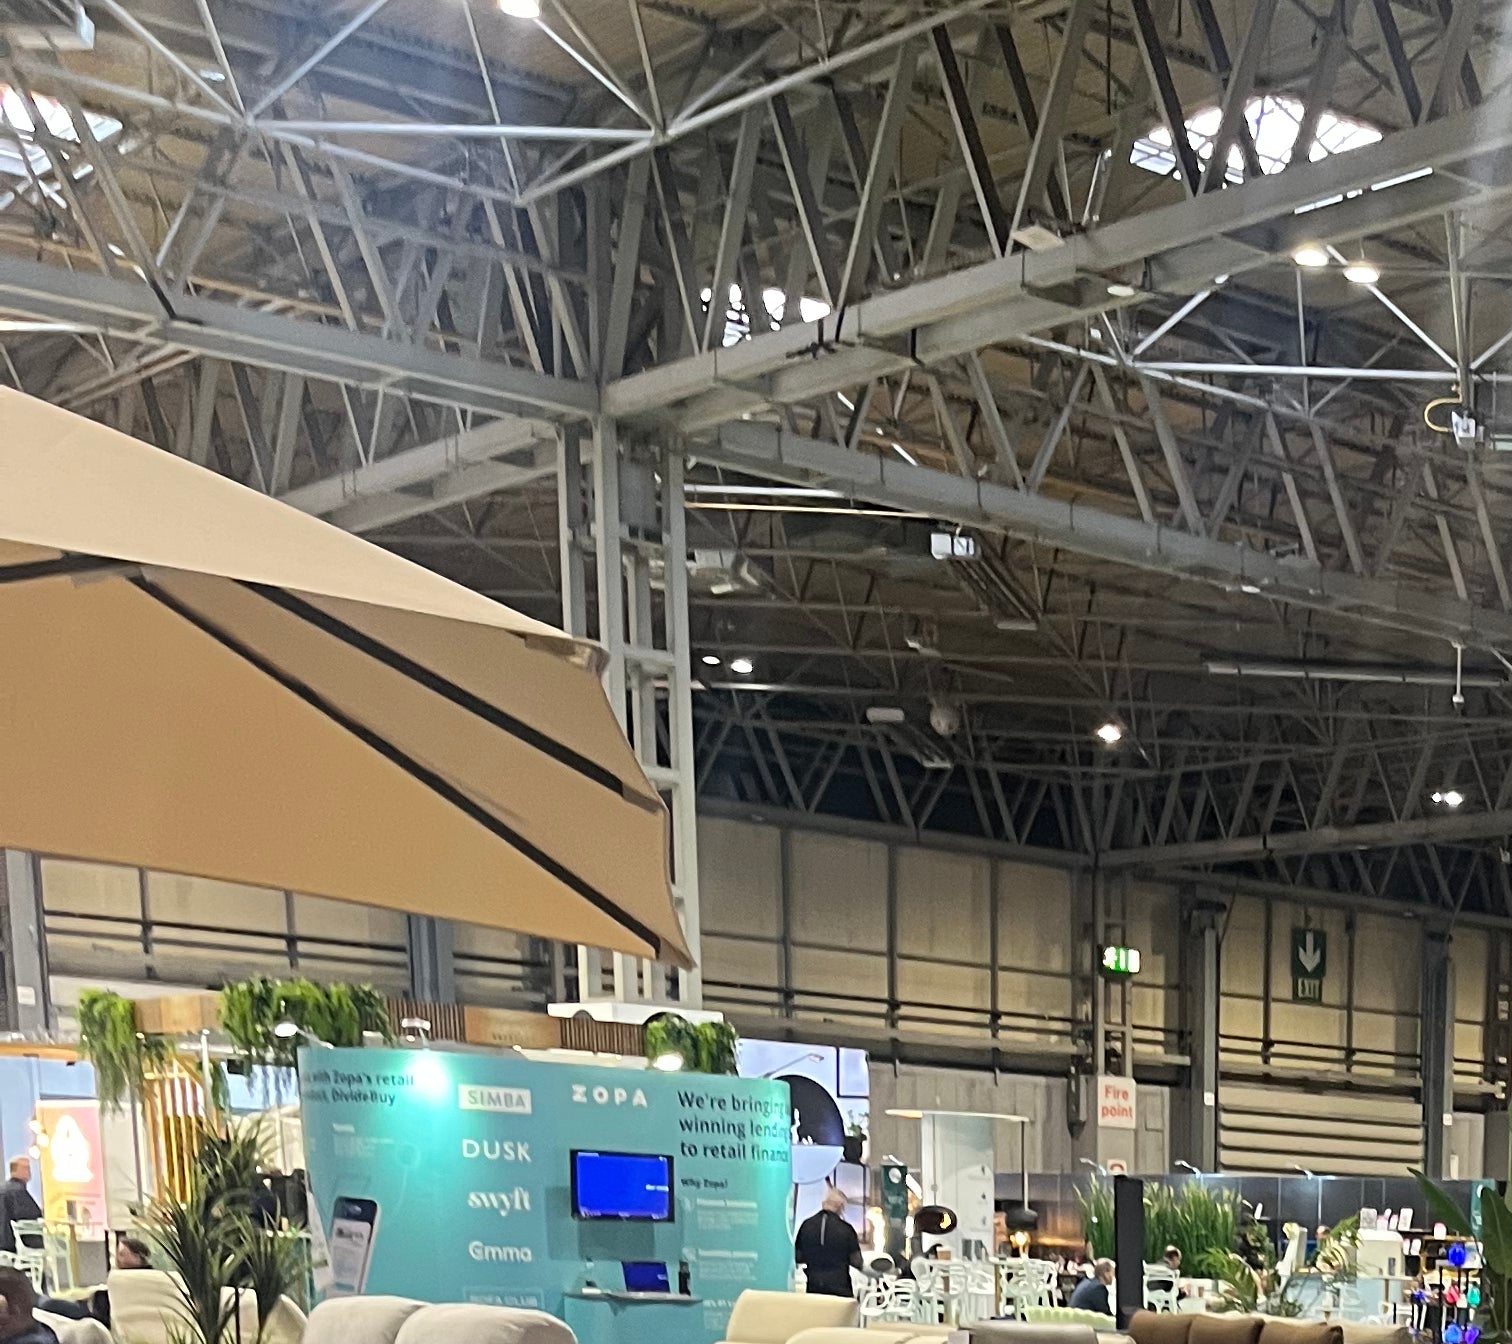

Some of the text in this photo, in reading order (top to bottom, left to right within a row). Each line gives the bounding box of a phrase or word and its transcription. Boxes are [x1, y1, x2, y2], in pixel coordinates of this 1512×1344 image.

[1298, 978, 1320, 999] EXIT
[467, 1089, 527, 1109] SIMBA
[571, 1083, 648, 1108] ZOPA
[677, 1090, 727, 1111] We're
[1104, 1085, 1129, 1101] Fire
[1101, 1105, 1133, 1122] point
[678, 1115, 746, 1140] winning
[462, 1139, 532, 1162] DUSK
[681, 1141, 697, 1157] to
[703, 1143, 746, 1160] retail
